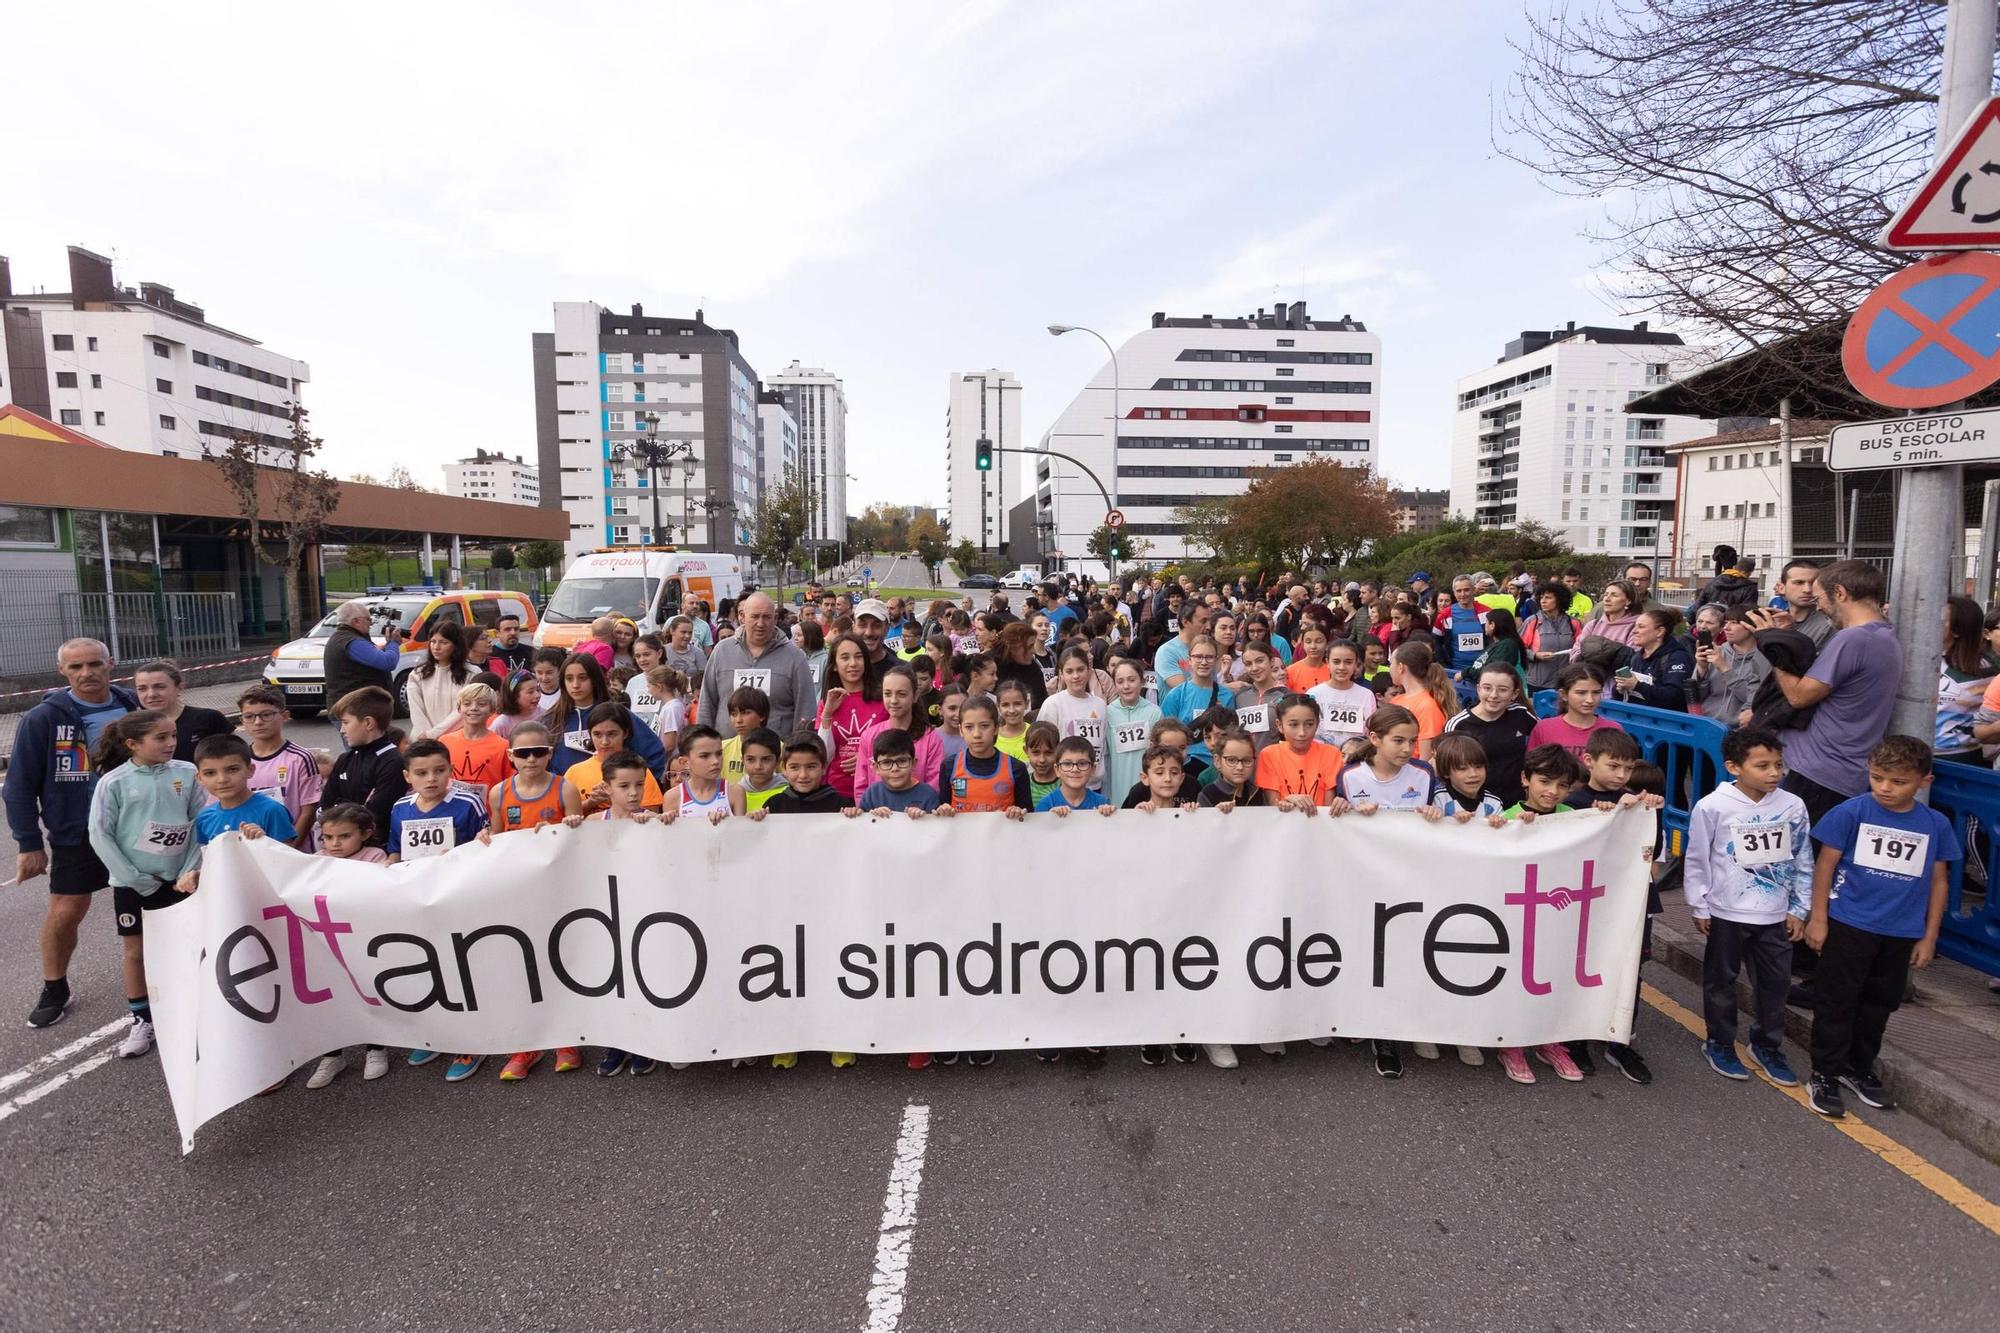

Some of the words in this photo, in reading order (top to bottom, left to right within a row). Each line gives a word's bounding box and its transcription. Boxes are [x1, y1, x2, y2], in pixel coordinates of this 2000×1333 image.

[1882, 417, 1963, 435] EXCEPTO
[1860, 438, 1893, 450] BUS
[1901, 430, 1985, 447] ESCOLAR
[1893, 451, 1902, 461] 5
[1909, 449, 1943, 460] min.
[963, 641, 977, 650] 352
[1462, 637, 1480, 646] 290
[740, 676, 764, 688] 217
[1240, 711, 1262, 727] 308
[1330, 710, 1357, 724] 246
[1079, 725, 1100, 738] 311
[1119, 728, 1145, 744] 312
[148, 830, 188, 847] 289
[408, 828, 444, 847] 340
[1743, 831, 1783, 851] 317
[1871, 838, 1918, 861] 197
[200, 875, 708, 1024] ettando
[738, 924, 806, 1002] al
[837, 922, 1220, 1000] sindrome
[1246, 916, 1343, 992] de
[1372, 859, 1606, 998] rett
